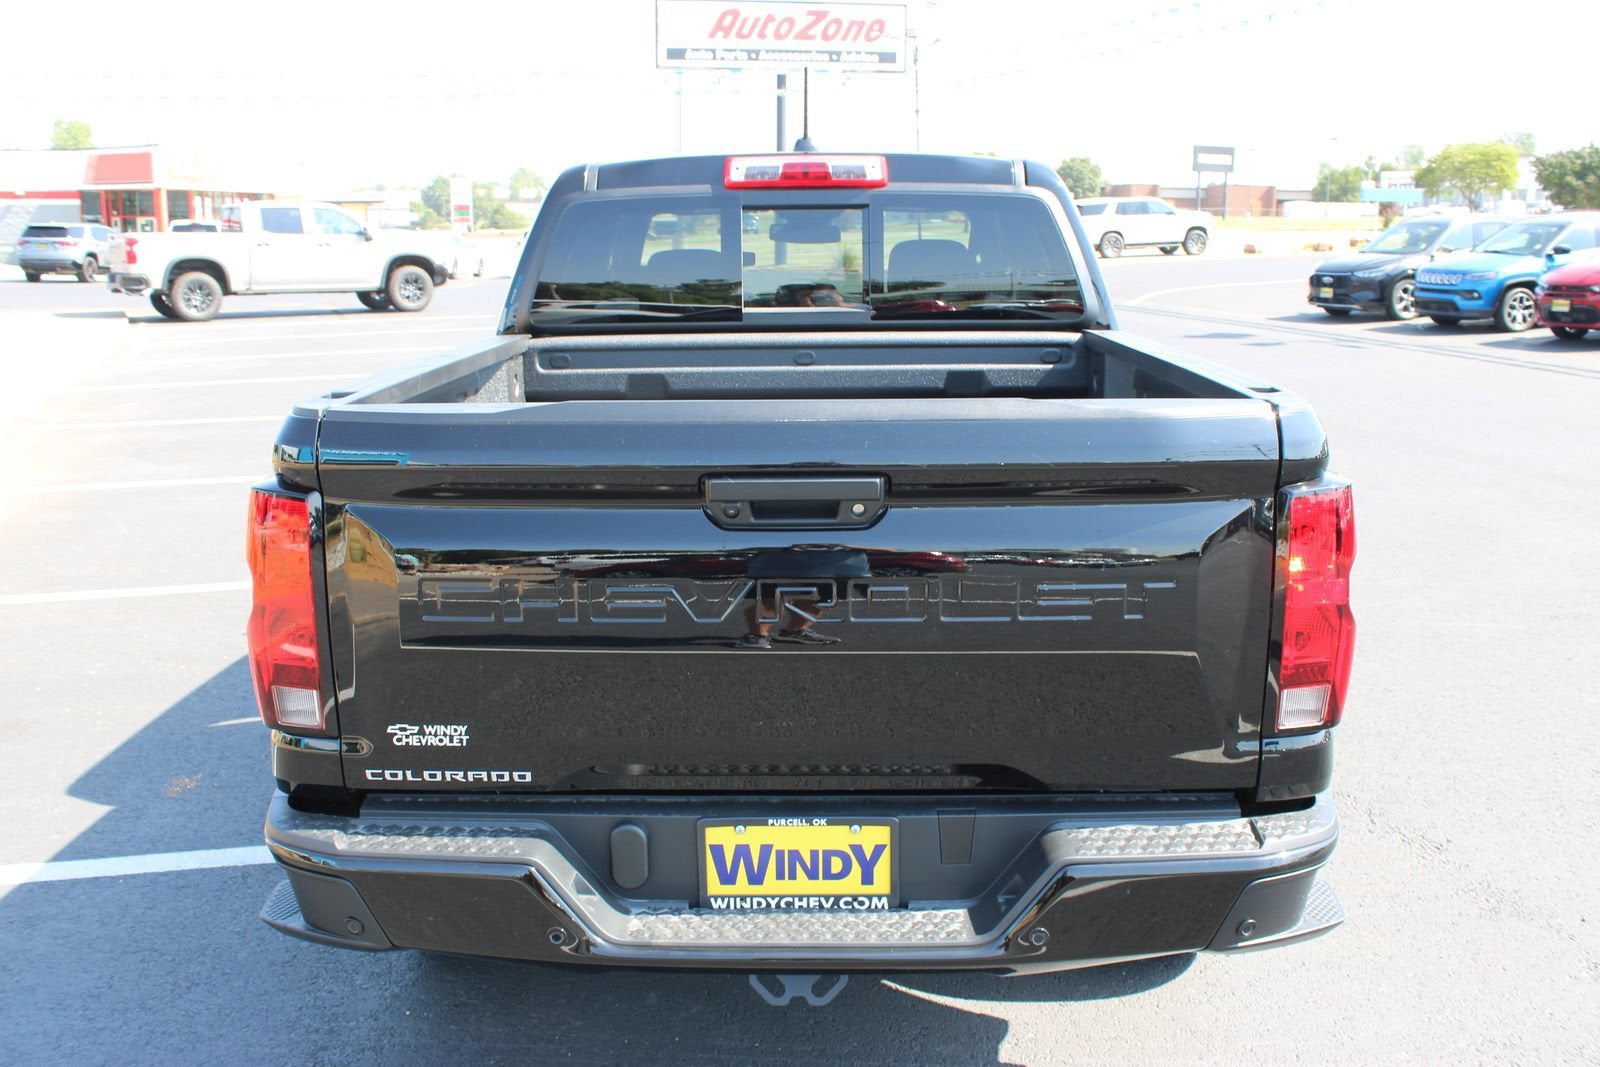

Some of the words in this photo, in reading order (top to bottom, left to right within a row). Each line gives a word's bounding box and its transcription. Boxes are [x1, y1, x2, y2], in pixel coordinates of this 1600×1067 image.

[707, 8, 886, 42] AutoZone
[417, 576, 1177, 623] CHEVROLET
[423, 724, 468, 736] WINDY
[392, 735, 469, 747] CHEVROLET
[365, 769, 532, 782] COLORADO
[768, 818, 809, 827] PURCELL,
[812, 818, 827, 826] OK
[708, 844, 888, 886] WINDY
[710, 896, 889, 910] WINDYCHEV.COM
